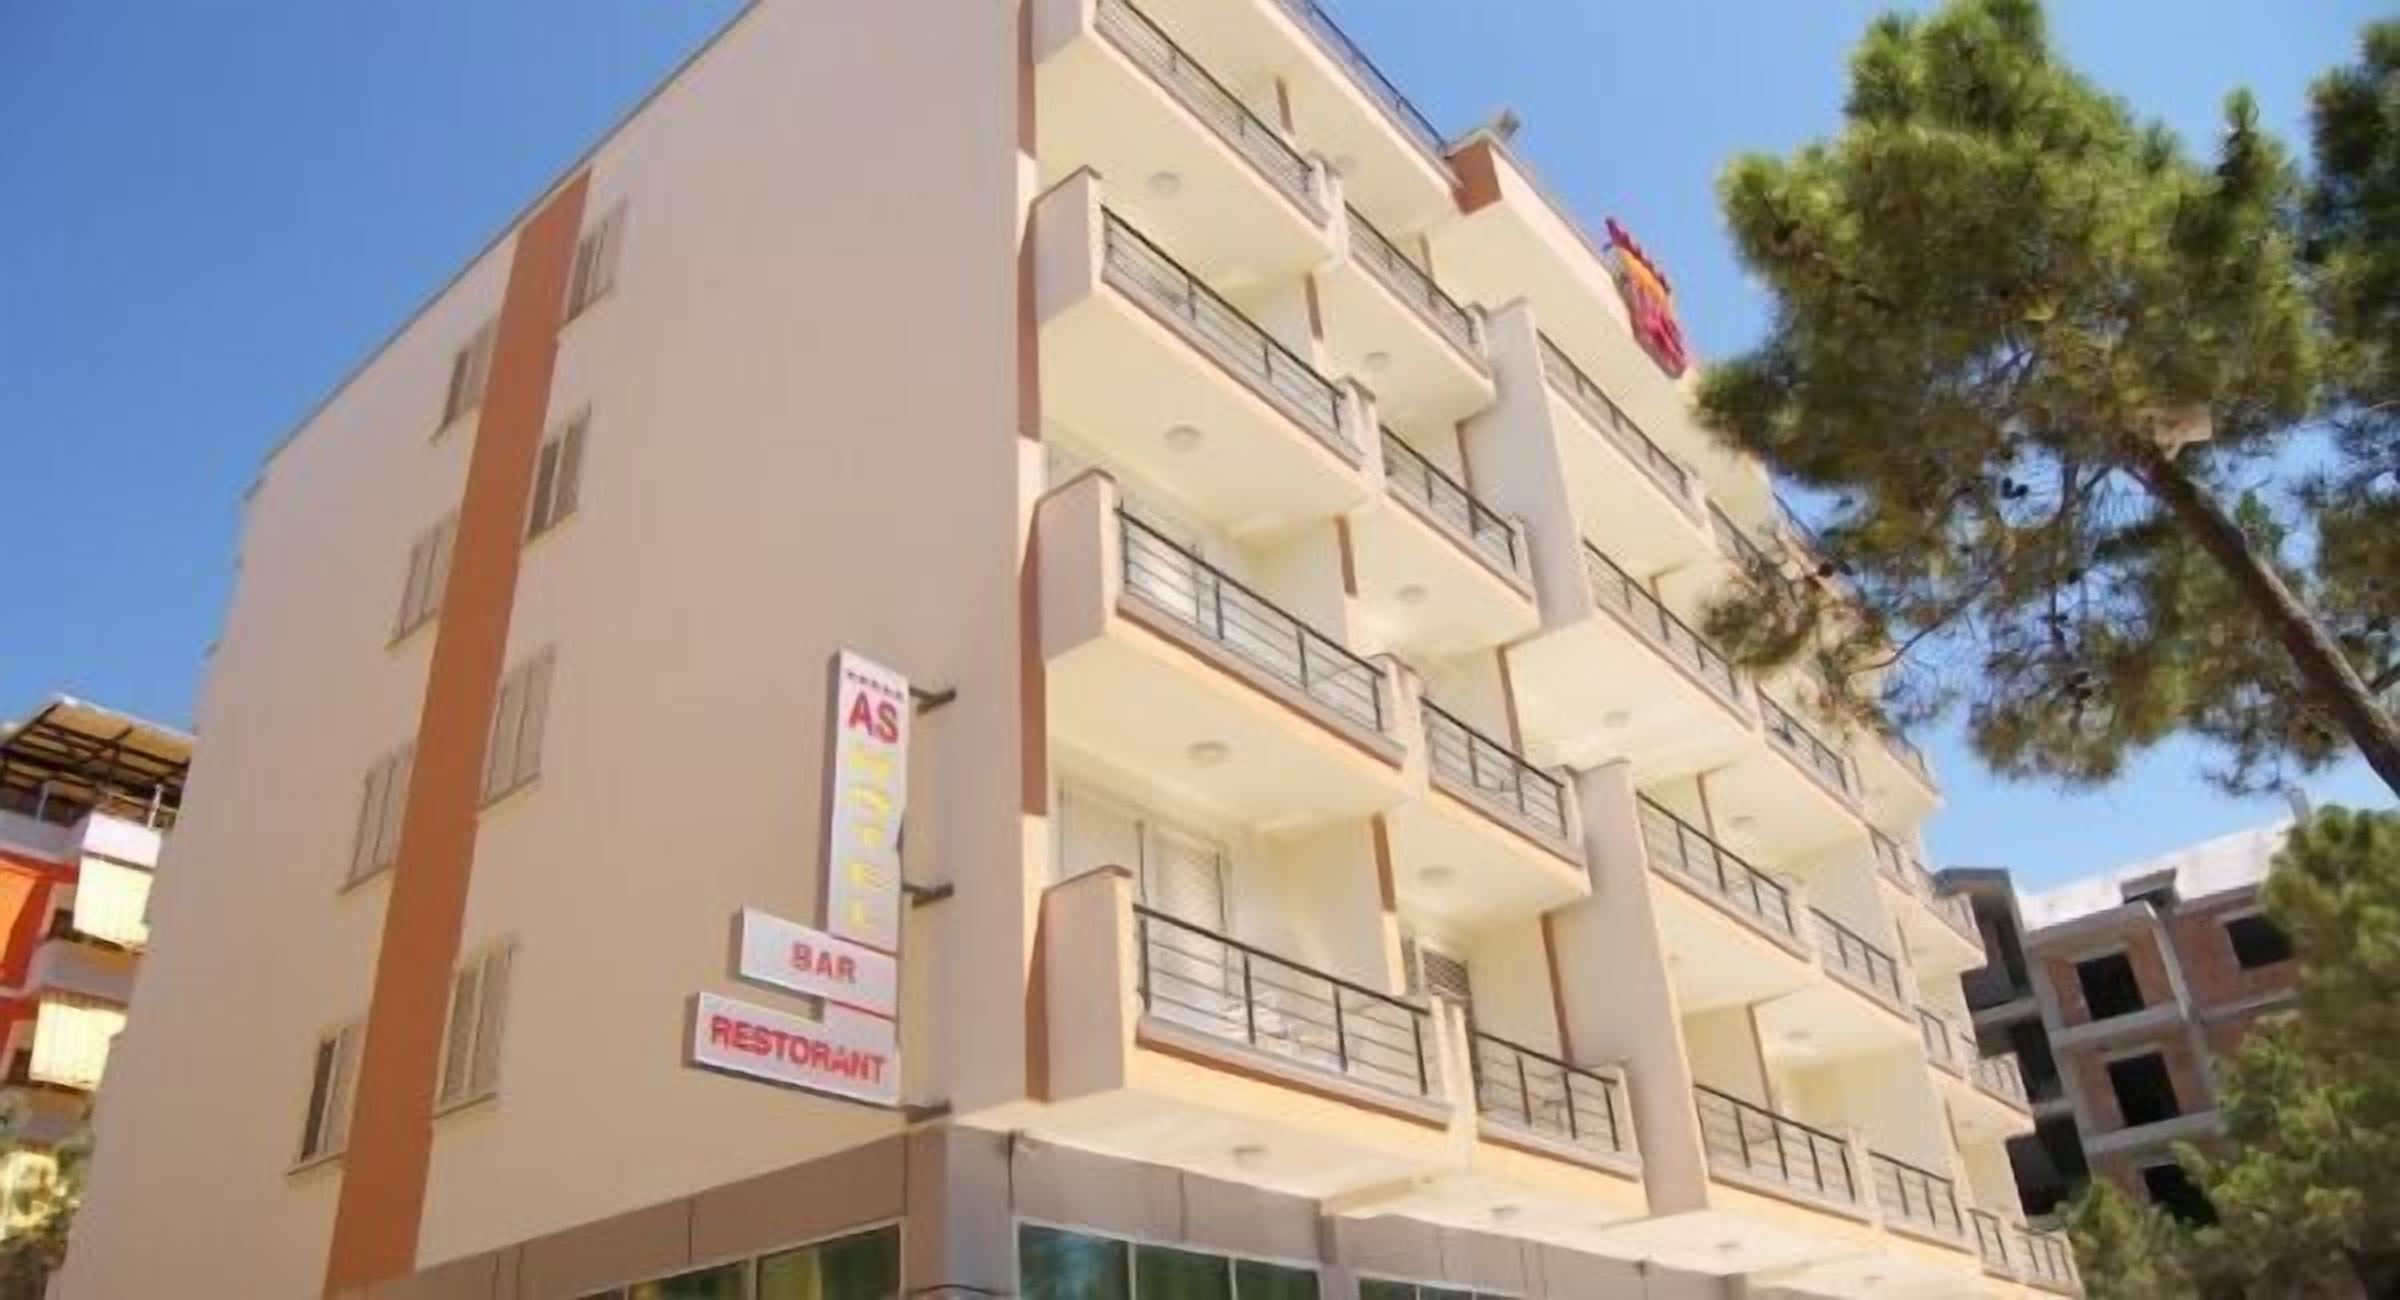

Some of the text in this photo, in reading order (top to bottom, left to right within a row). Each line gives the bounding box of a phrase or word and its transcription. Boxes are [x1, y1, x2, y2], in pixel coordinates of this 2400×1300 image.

[848, 691, 899, 744] AS
[791, 943, 857, 982] BAR
[710, 1016, 886, 1084] RESTORANT
